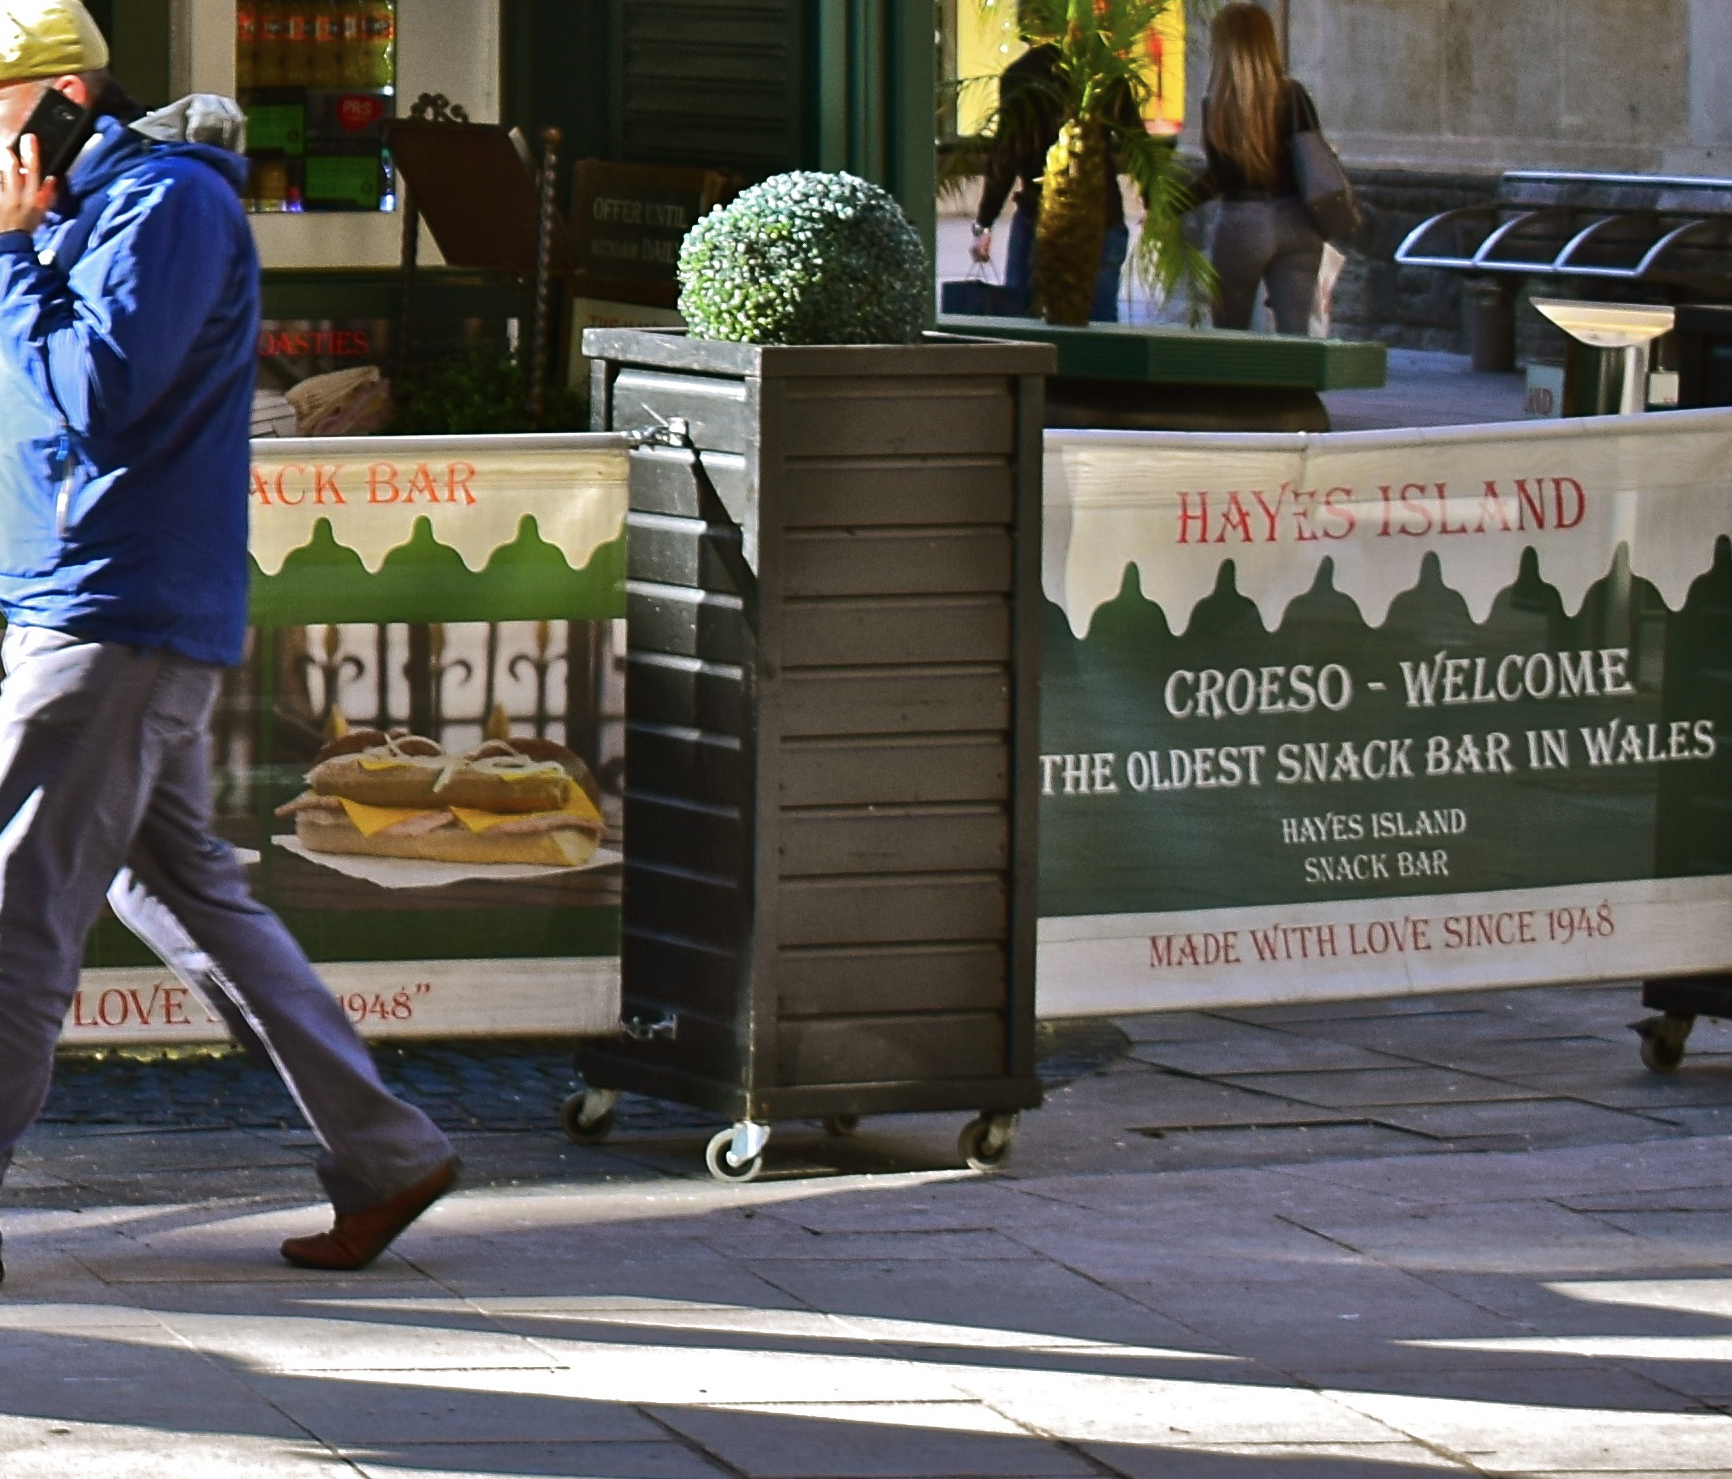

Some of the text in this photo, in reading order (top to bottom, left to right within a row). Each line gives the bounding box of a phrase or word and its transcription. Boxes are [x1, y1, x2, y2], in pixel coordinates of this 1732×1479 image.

[250, 460, 478, 506] ACK BAR
[1175, 475, 1588, 545] HAYES ISLAND
[1163, 663, 1353, 720] CROESO
[1399, 647, 1634, 709] WELCOME
[1040, 717, 1717, 797] THE OLDEST SNACK BAR IN WALES
[1281, 807, 1467, 845] HAYES ISLAND
[1303, 849, 1450, 883] SNACK BAR
[1147, 897, 1616, 968] MADE WITH LOVE SINCE 1948
[71, 984, 191, 1027] LOVE
